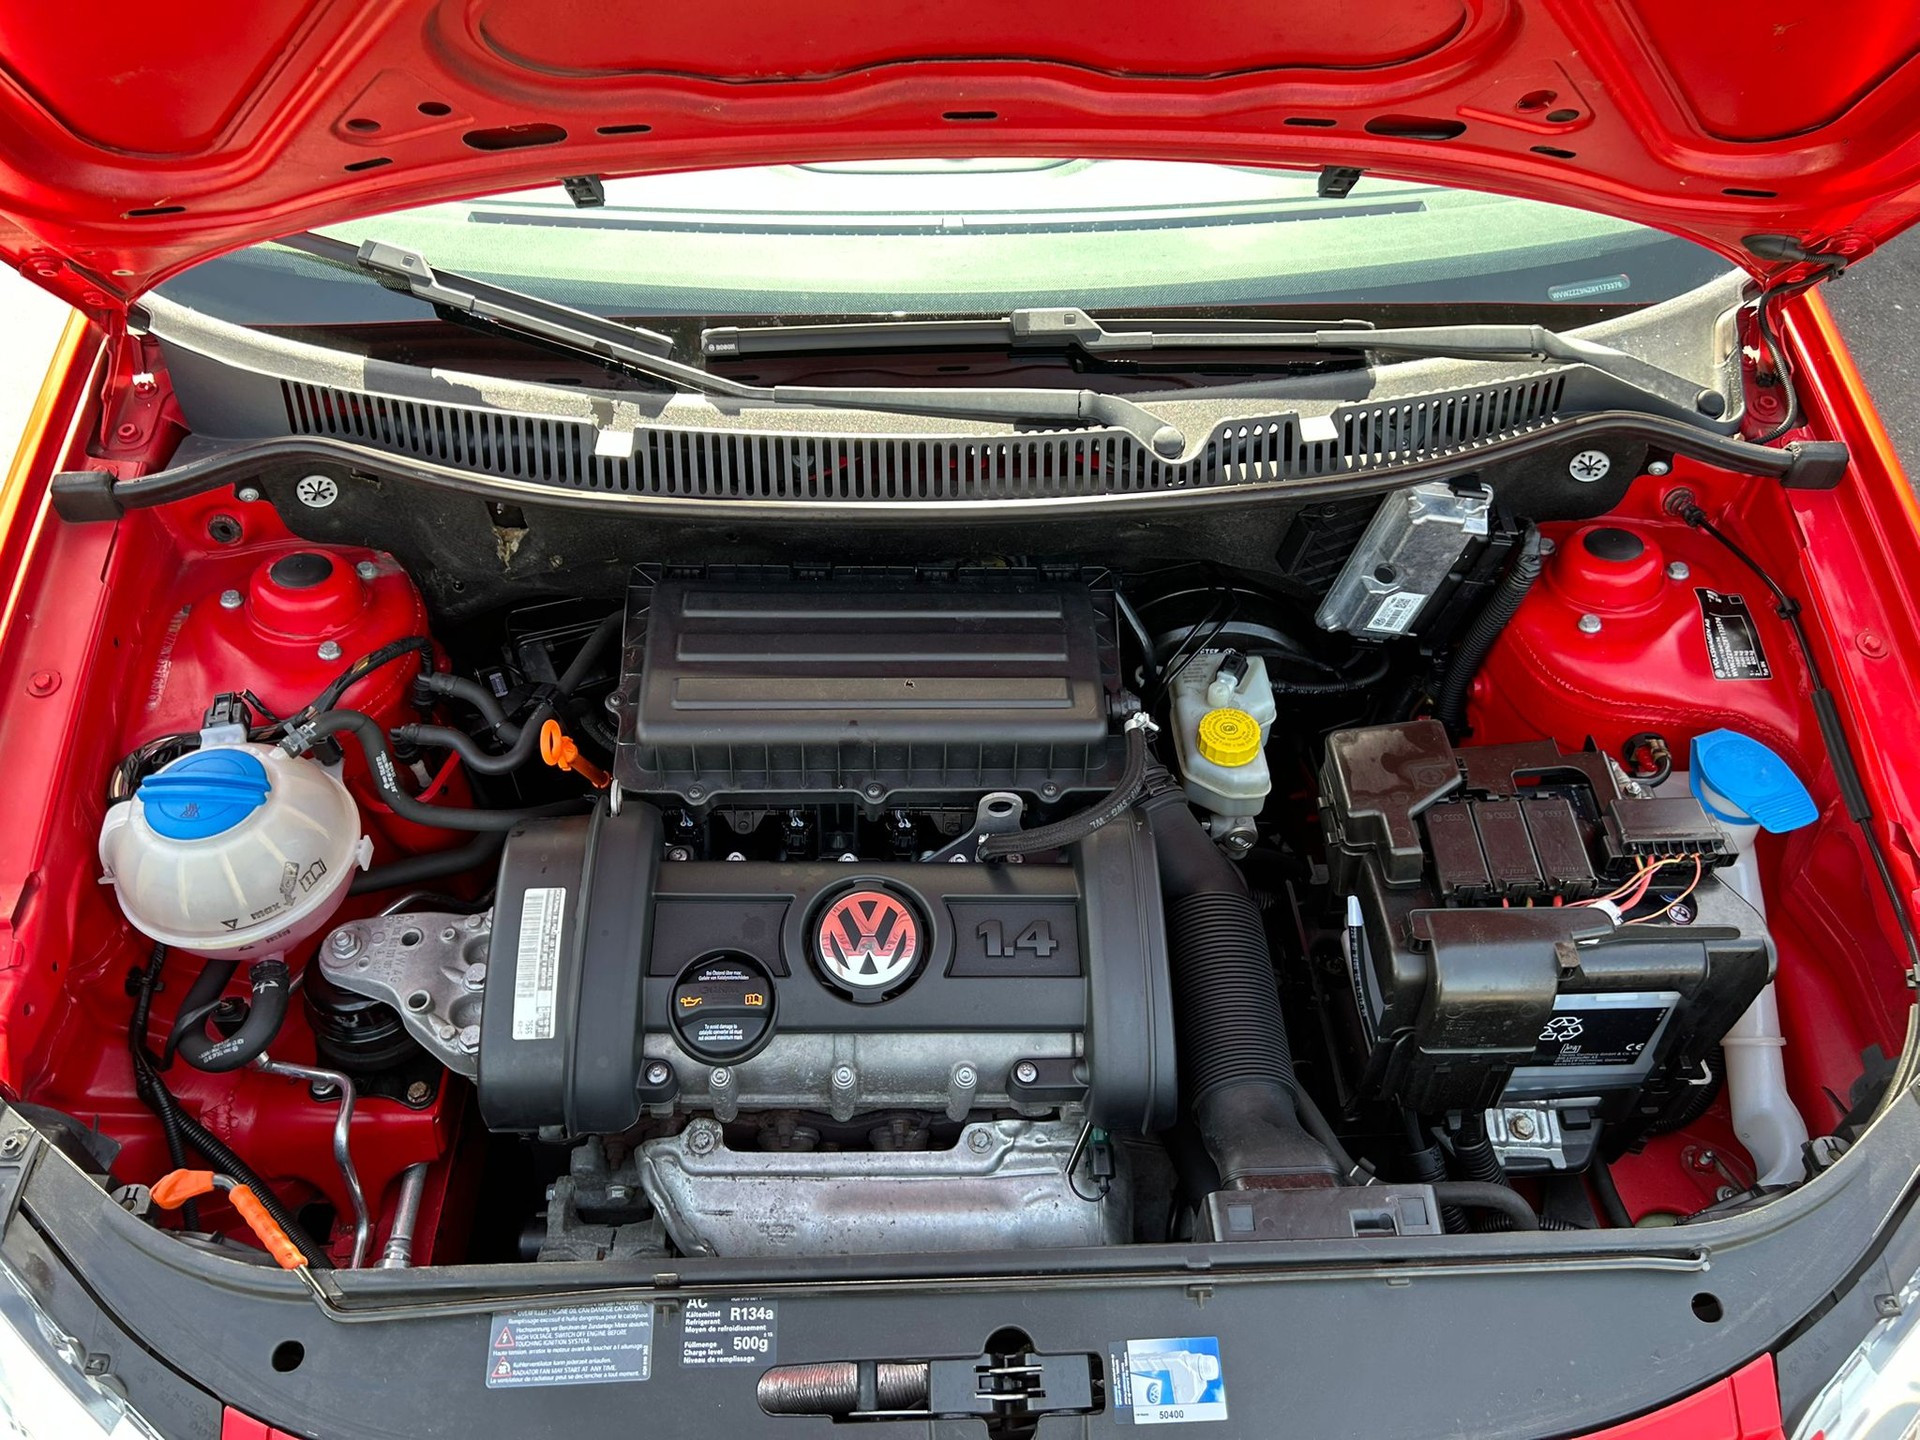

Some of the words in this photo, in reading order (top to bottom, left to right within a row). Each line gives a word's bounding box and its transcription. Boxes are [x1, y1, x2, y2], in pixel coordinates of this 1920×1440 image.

[1704, 618, 1711, 628] AG
[1705, 628, 1721, 669] VOLKSWAGEN
[250, 902, 281, 920] max
[976, 918, 1058, 957] 1.4
[687, 1299, 708, 1308] AC
[730, 1307, 774, 1321] R134a
[685, 1326, 706, 1334] Moyen
[684, 1341, 717, 1349] Füllmenge
[733, 1336, 768, 1352] 500g
[717, 1356, 755, 1364] remplissage
[1159, 1409, 1184, 1420] 50400
